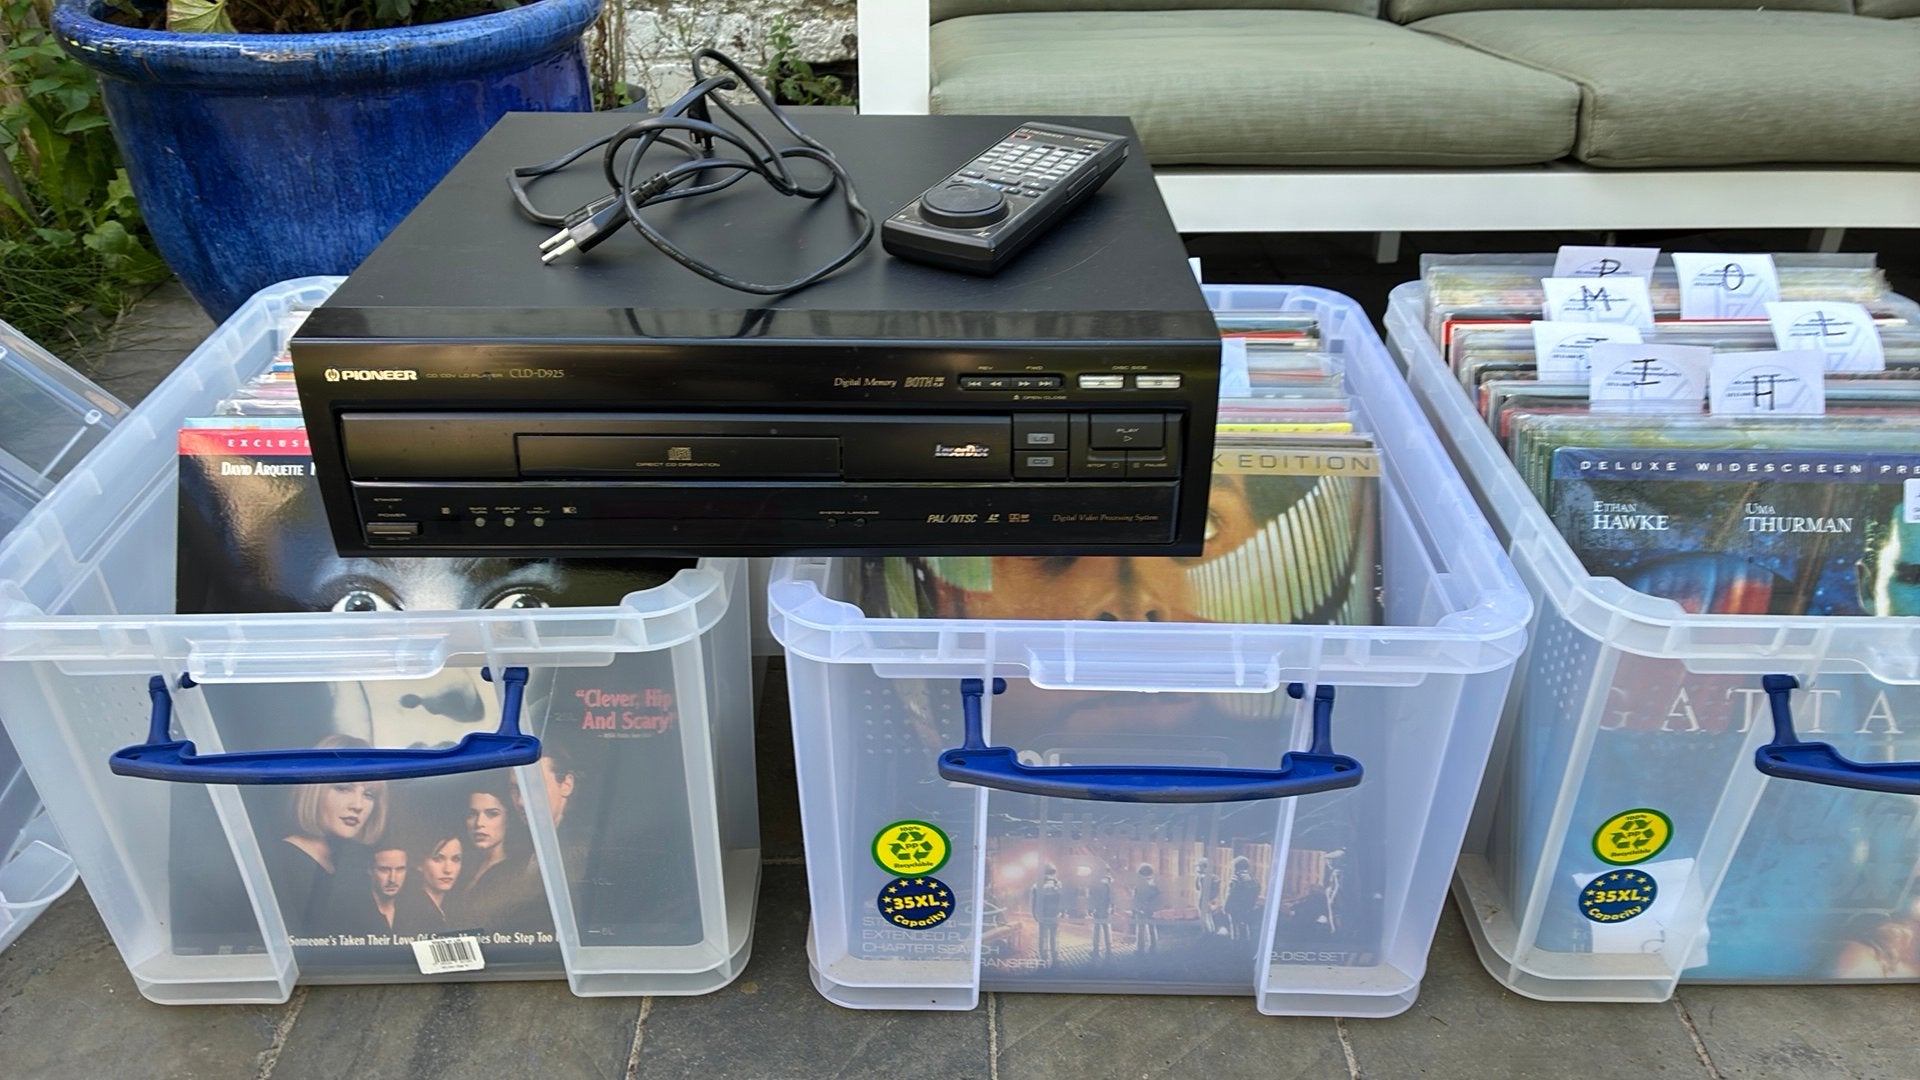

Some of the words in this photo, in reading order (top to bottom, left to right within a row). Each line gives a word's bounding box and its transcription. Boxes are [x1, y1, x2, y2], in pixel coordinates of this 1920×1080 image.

[1580, 285, 1612, 311] M
[341, 370, 418, 381] PIONEER
[509, 368, 565, 379] CLD-D925
[833, 376, 861, 387] Digital
[864, 376, 898, 388] Memory
[904, 377, 934, 388] BOTH
[1238, 454, 1371, 470] EDITION
[1580, 461, 1678, 471] DELUXE
[1697, 462, 1862, 474] WIDESCREEN
[1880, 465, 1920, 474] PRE
[927, 514, 978, 524] PAL/NTSC
[1052, 514, 1077, 522] Digital
[1592, 515, 1669, 531] HAWKE
[1743, 517, 1854, 533] THURMAN
[644, 688, 673, 711] Hip
[582, 711, 616, 730] And
[894, 861, 934, 869] Recyclable
[892, 894, 941, 911] 35XL
[1594, 889, 1641, 903] 35XL
[893, 910, 947, 928] Capacity
[1587, 905, 1642, 921] Capacity
[289, 934, 338, 946] Someone's
[339, 934, 365, 946] Taken
[367, 933, 391, 946] Their
[393, 933, 415, 945] Love
[492, 932, 511, 944] One
[514, 931, 535, 945] Step
[537, 931, 553, 943] Too
[862, 930, 945, 941] EXTENDED
[862, 943, 936, 953] CHAPTER
[1319, 951, 1349, 961] SET
[974, 958, 1047, 968] RANSFER
